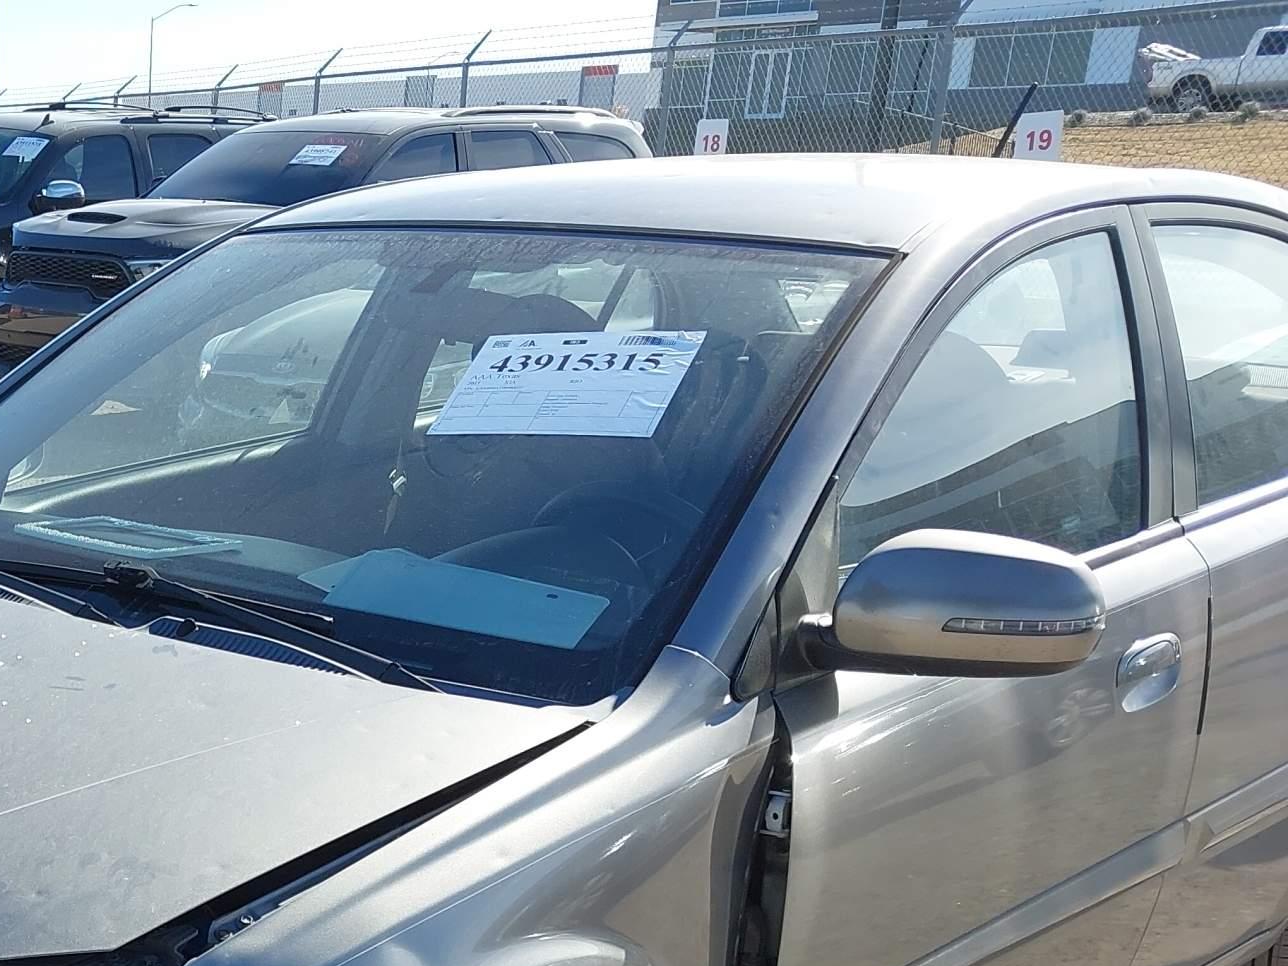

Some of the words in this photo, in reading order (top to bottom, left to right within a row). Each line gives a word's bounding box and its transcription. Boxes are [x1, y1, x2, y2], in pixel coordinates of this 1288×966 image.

[703, 134, 720, 152] 18
[1027, 130, 1052, 150] 19
[489, 353, 664, 373] 43915315
